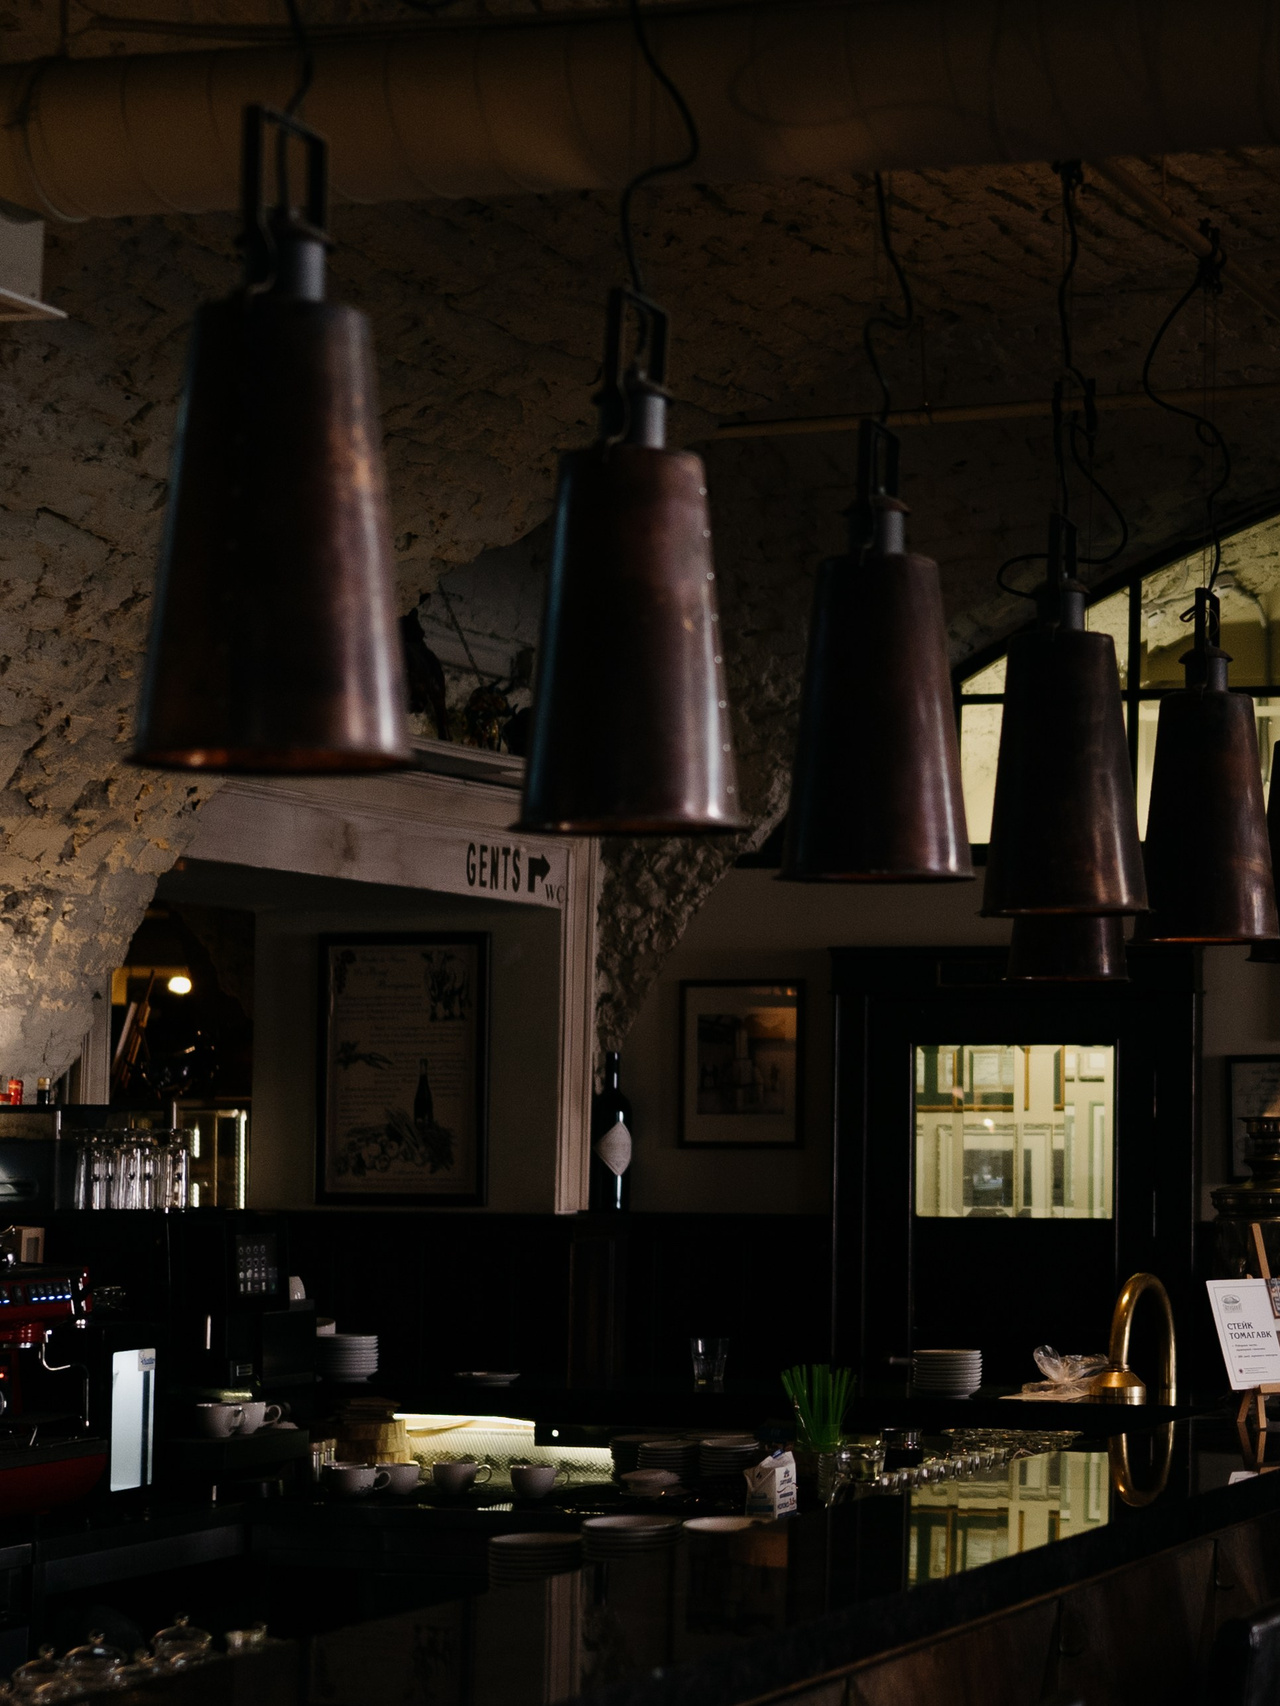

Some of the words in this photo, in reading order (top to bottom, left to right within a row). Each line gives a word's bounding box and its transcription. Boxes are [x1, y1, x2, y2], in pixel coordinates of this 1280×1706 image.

[466, 842, 520, 893] GENTS
[545, 883, 565, 904] WC
[1226, 1321, 1254, 1330] СТЕЙК
[1228, 1330, 1273, 1340] ТОМАГАВК
